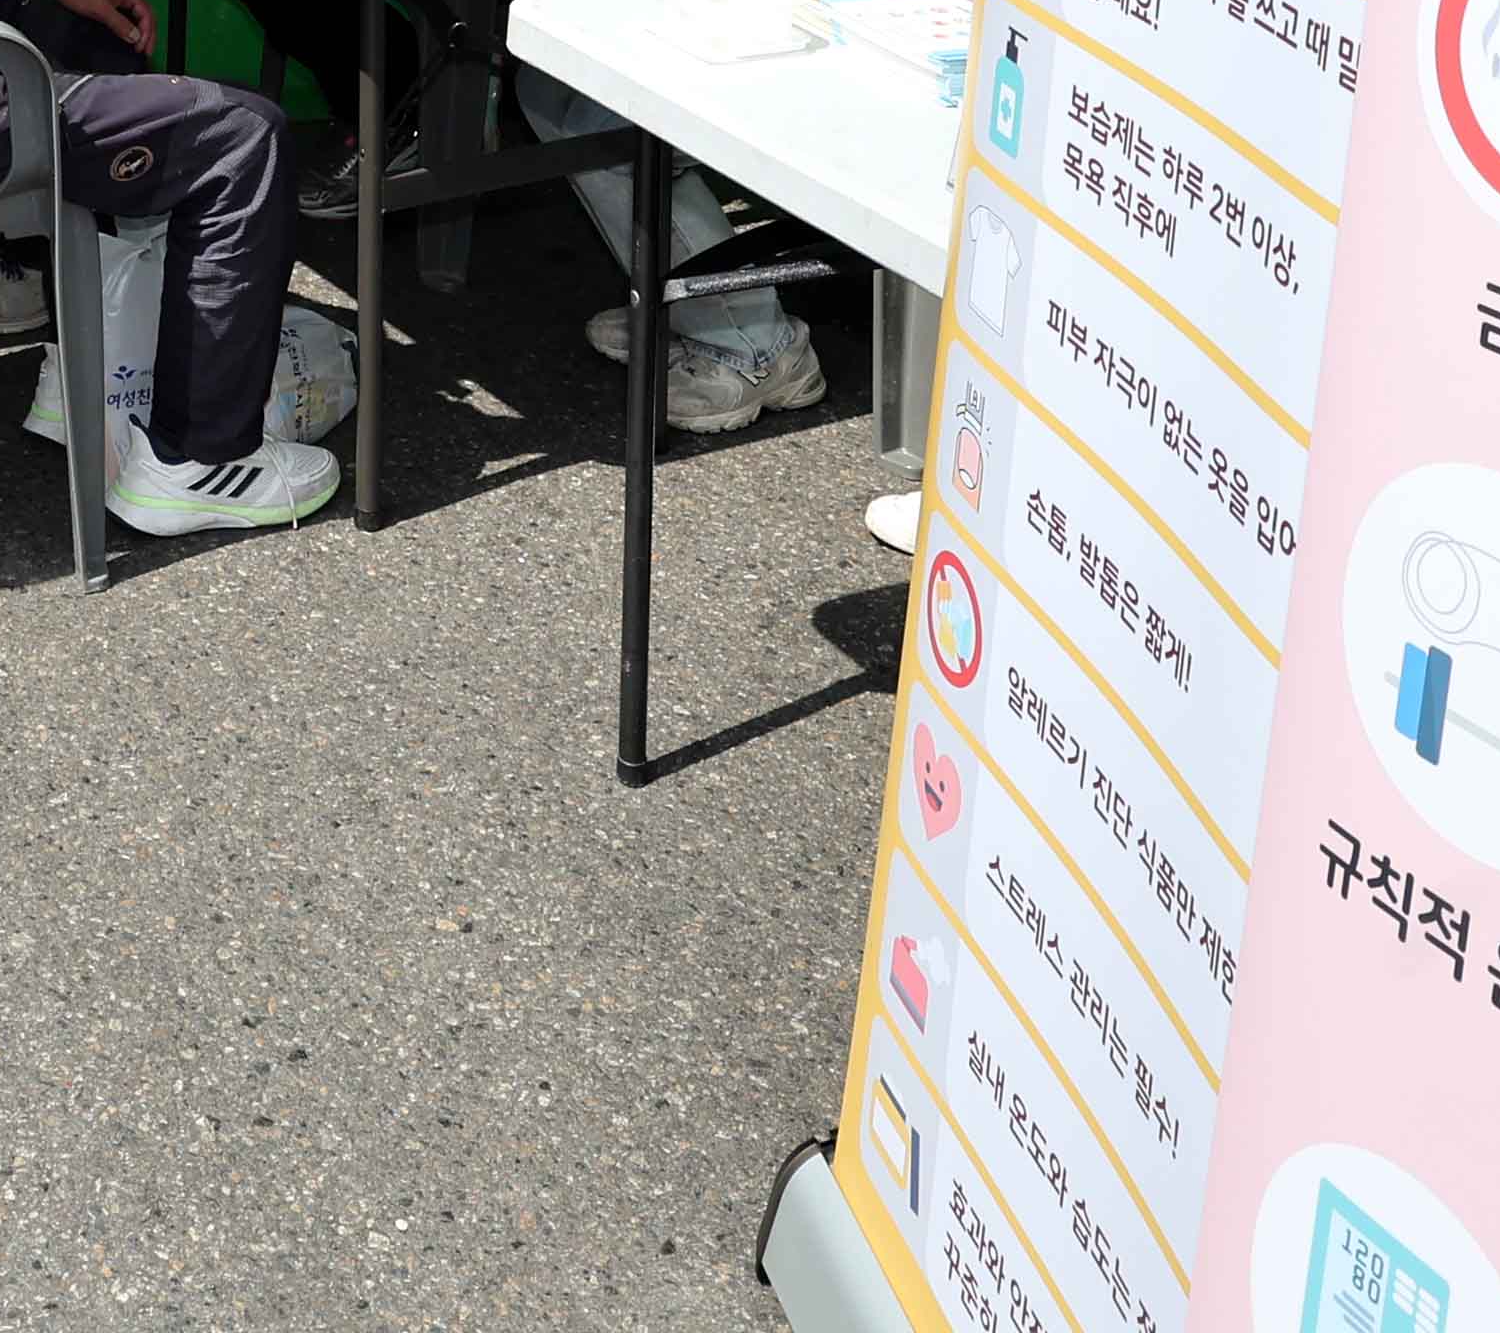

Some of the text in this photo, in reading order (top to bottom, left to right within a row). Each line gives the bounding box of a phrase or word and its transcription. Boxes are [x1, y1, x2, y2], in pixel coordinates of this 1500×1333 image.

[1306, 18, 1330, 72] 때
[1062, 141, 1178, 258] 목욕 직후에
[1067, 84, 1301, 295] 보습제는 하루 2번 이상,
[1044, 299, 1089, 360] 피부
[1092, 336, 1159, 426] 자극이
[1162, 398, 1203, 475] 없는
[1207, 447, 1251, 526] 옷을
[1025, 488, 1194, 693] 손톱, 발톱은 짧게!
[1006, 665, 1087, 790] 알레르기
[1091, 763, 1133, 849] 진단
[1138, 828, 1198, 943] 식품만
[1316, 818, 1473, 984] 규칙적
[985, 854, 1181, 1161] 스트레스 관리는 필수!
[949, 1177, 1006, 1295] 효과와
[968, 1029, 1131, 1323] 실내 온도와 습도는
[1341, 1228, 1385, 1281] 120
[943, 1231, 998, 1333] 꾸준히
[1351, 1263, 1382, 1305] 80
